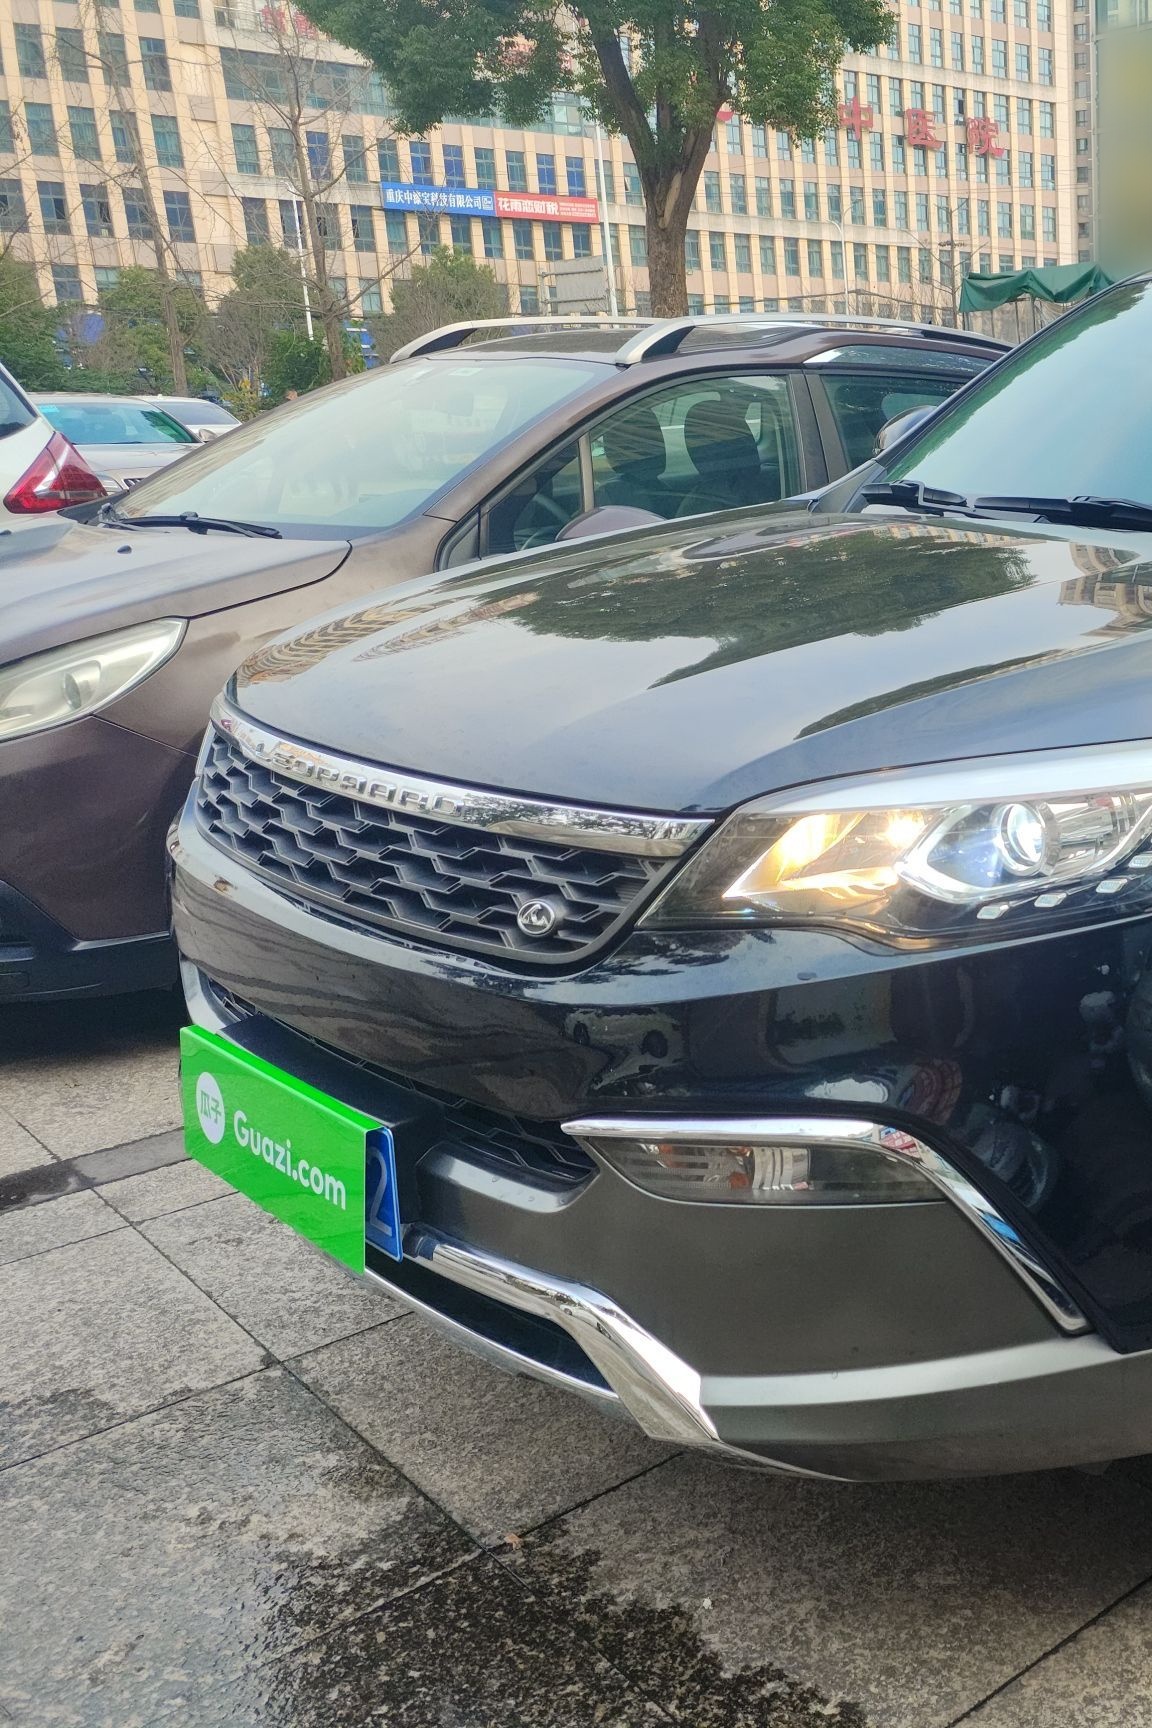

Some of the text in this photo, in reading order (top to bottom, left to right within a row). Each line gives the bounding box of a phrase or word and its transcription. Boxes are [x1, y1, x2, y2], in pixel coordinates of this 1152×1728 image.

[839, 96, 1005, 158] 中医院
[367, 1146, 393, 1237] 2
